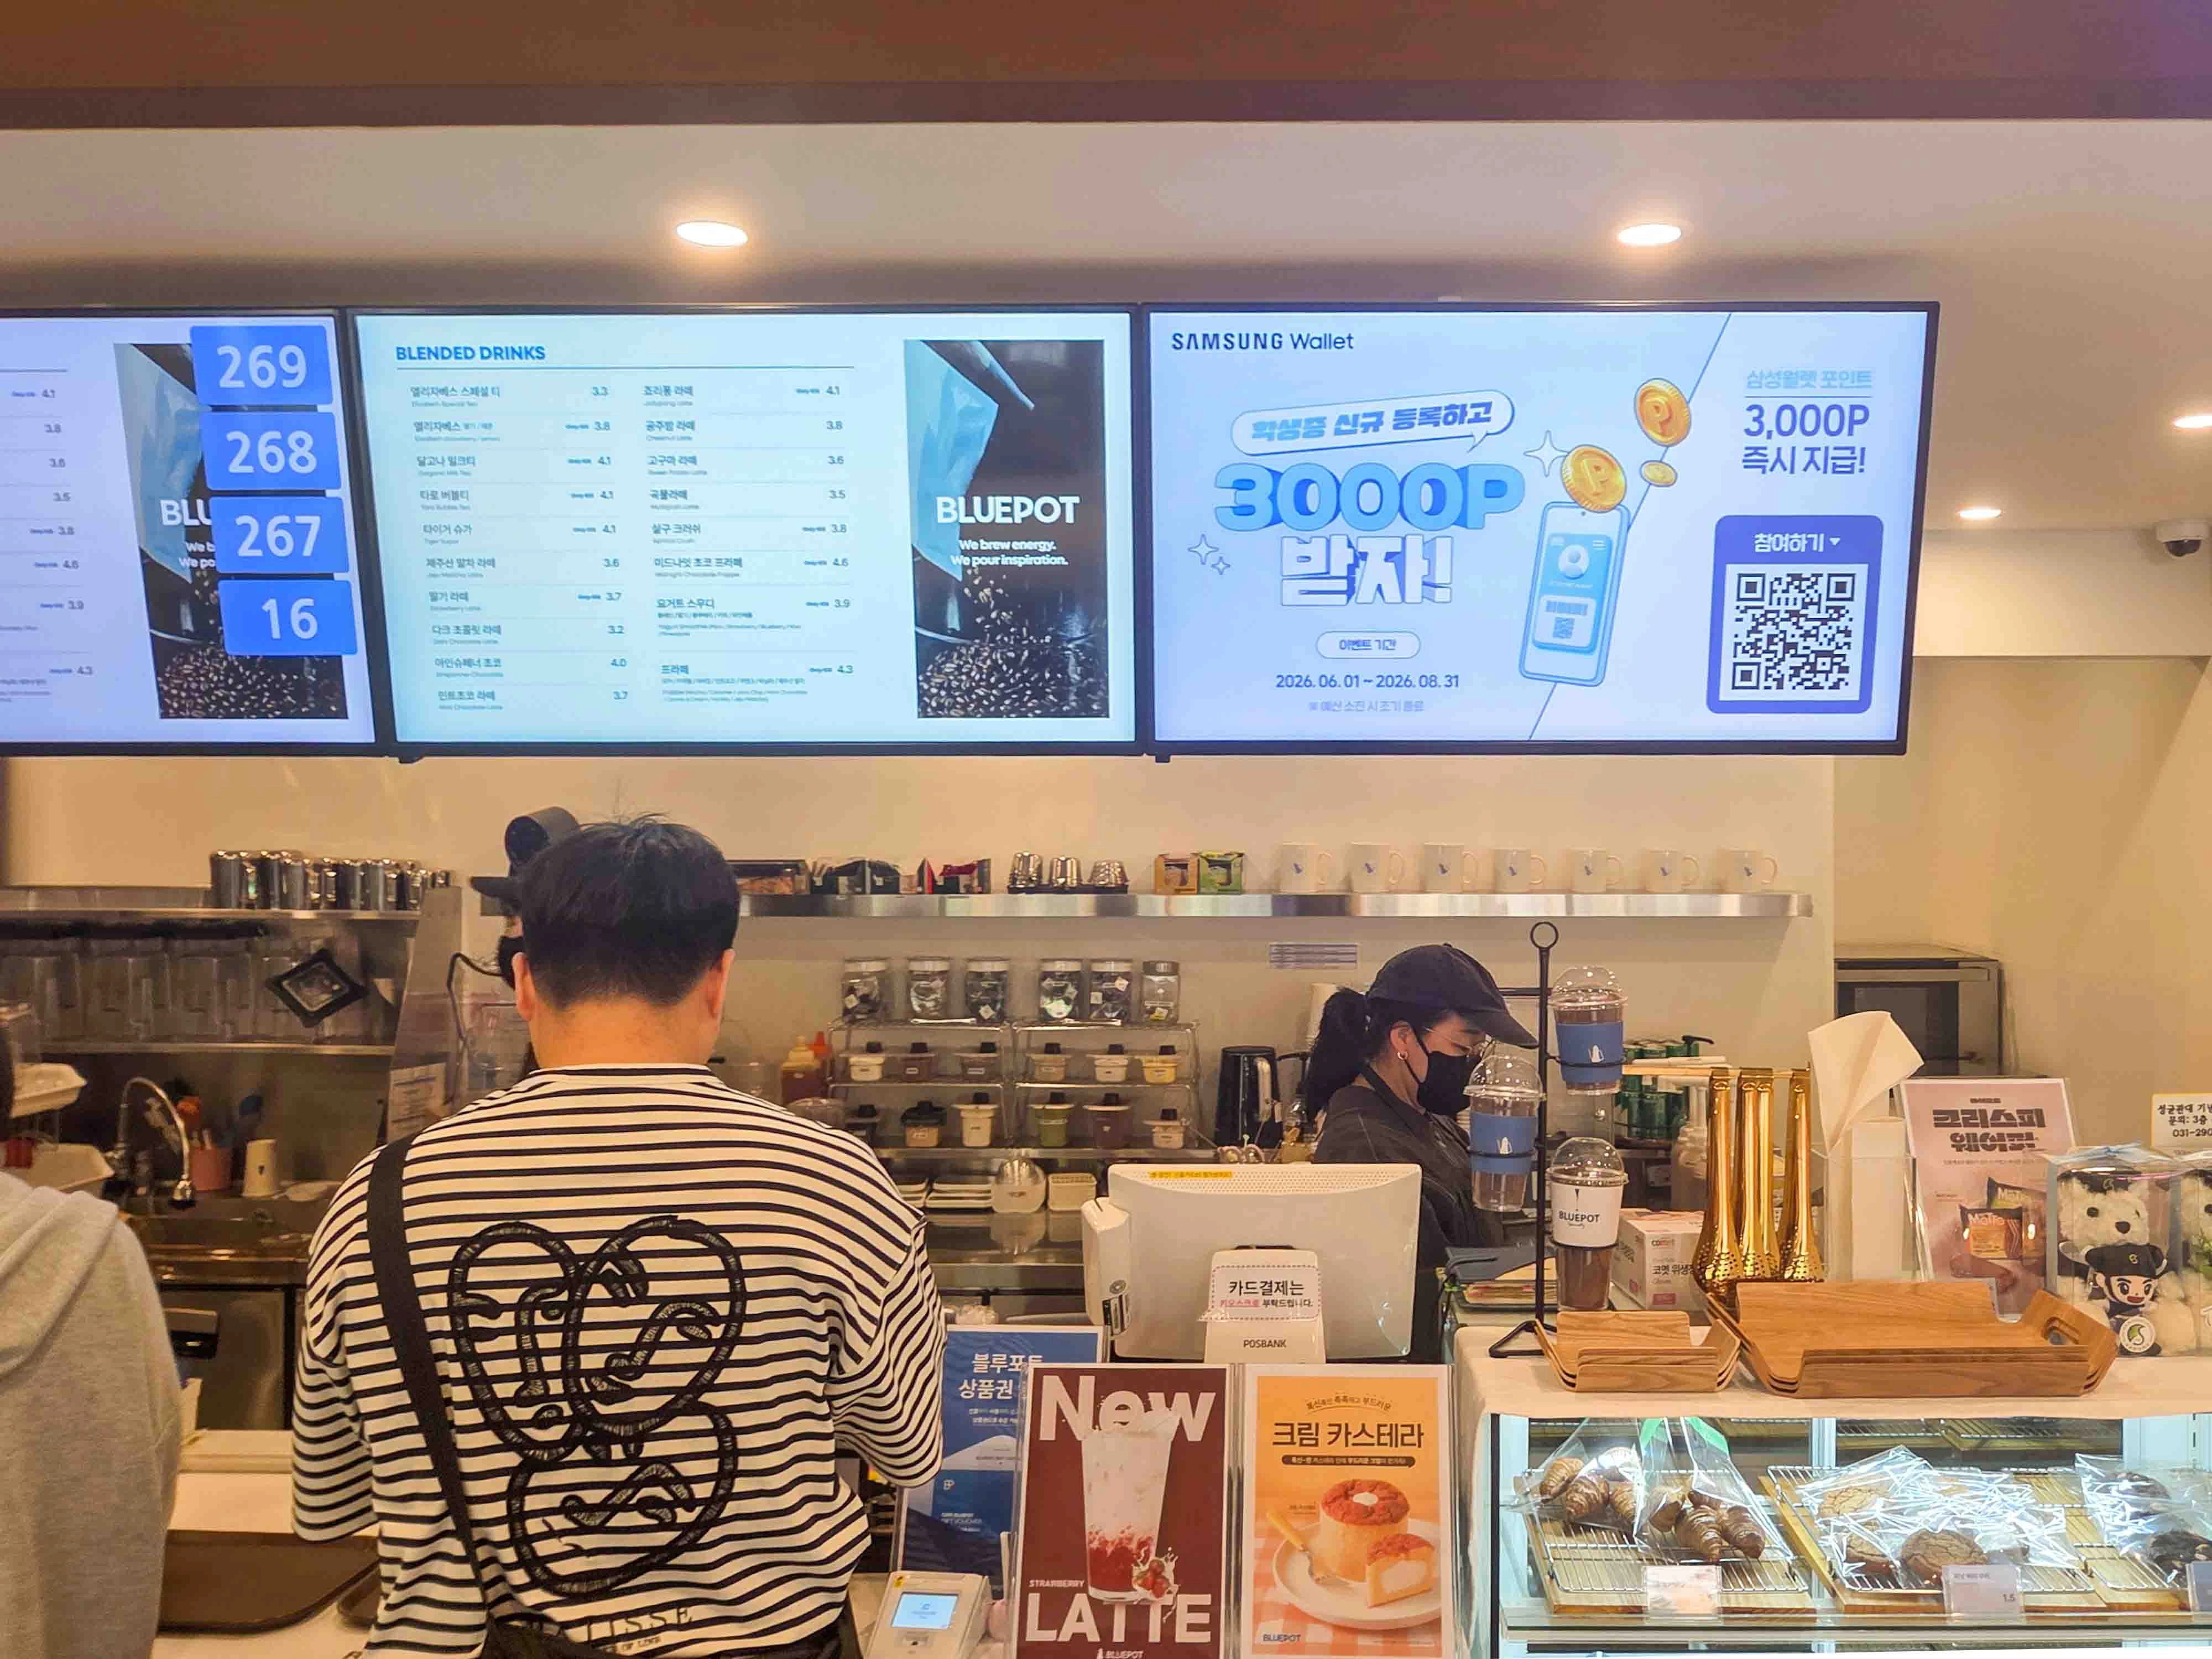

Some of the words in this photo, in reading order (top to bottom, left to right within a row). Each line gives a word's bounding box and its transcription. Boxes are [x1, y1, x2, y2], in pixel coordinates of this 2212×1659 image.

[1172, 333, 1283, 349] SAMSUNG
[1290, 333, 1354, 349] Wallet
[395, 346, 476, 360] BLENDED
[479, 346, 546, 360] DRINKS
[216, 345, 307, 388] 269
[1820, 369, 1872, 389] 포인트
[592, 387, 608, 396] 3.3
[826, 386, 840, 395] 4.1
[1334, 410, 1384, 436] 신규
[1392, 401, 1493, 430] 등록하고
[1744, 404, 1870, 440] 3,000P
[594, 421, 611, 431] 3.8
[827, 421, 843, 430] 3.8
[226, 431, 318, 474] 268
[598, 456, 611, 465] 4.1
[828, 456, 844, 465] 3.6
[1742, 446, 1797, 474] 즉시
[1803, 446, 1866, 474] 지급!
[601, 491, 614, 499] 4.1
[830, 490, 846, 499] 3.5
[1214, 462, 1525, 531] 3000P
[161, 499, 212, 526] BLU
[936, 496, 1080, 524] BLUEPOT
[602, 525, 617, 533] 4.1
[831, 524, 847, 533] 3.8
[234, 515, 322, 557] 267
[958, 540, 978, 550] We
[980, 540, 1010, 550] brew
[1012, 541, 1057, 552] energy.
[1754, 533, 1824, 552] 참여하기
[603, 559, 619, 567] 3.6
[832, 558, 849, 567] 4.6
[951, 555, 971, 566] We
[972, 557, 999, 568] pour
[1281, 534, 1452, 607] 받자!
[606, 592, 622, 601] 3.7
[834, 599, 851, 608] 3.9
[262, 598, 319, 639] 16
[608, 625, 624, 634] 3.2
[1339, 639, 1372, 651] 이벤트
[1374, 639, 1397, 651] 기간
[610, 659, 627, 667] 4.0
[837, 665, 853, 674] 4.3
[613, 691, 629, 700] 3.7
[1933, 1109, 2046, 1128] 크리스피
[1559, 1211, 1600, 1223] BLUEPOT
[1229, 1280, 1305, 1296] 카드결제는
[1243, 1339, 1287, 1348] POSBANK
[958, 1379, 1014, 1400] 상품권
[1040, 1375, 1216, 1442] New
[1272, 1422, 1319, 1447] 크림
[1327, 1422, 1425, 1448] 카스테라
[1029, 1579, 1085, 1588] STRAWBERRY
[2002, 1593, 2016, 1601] 1.5
[1025, 1593, 1212, 1642] LATTE
[1263, 1634, 1301, 1642] BLUEPOT
